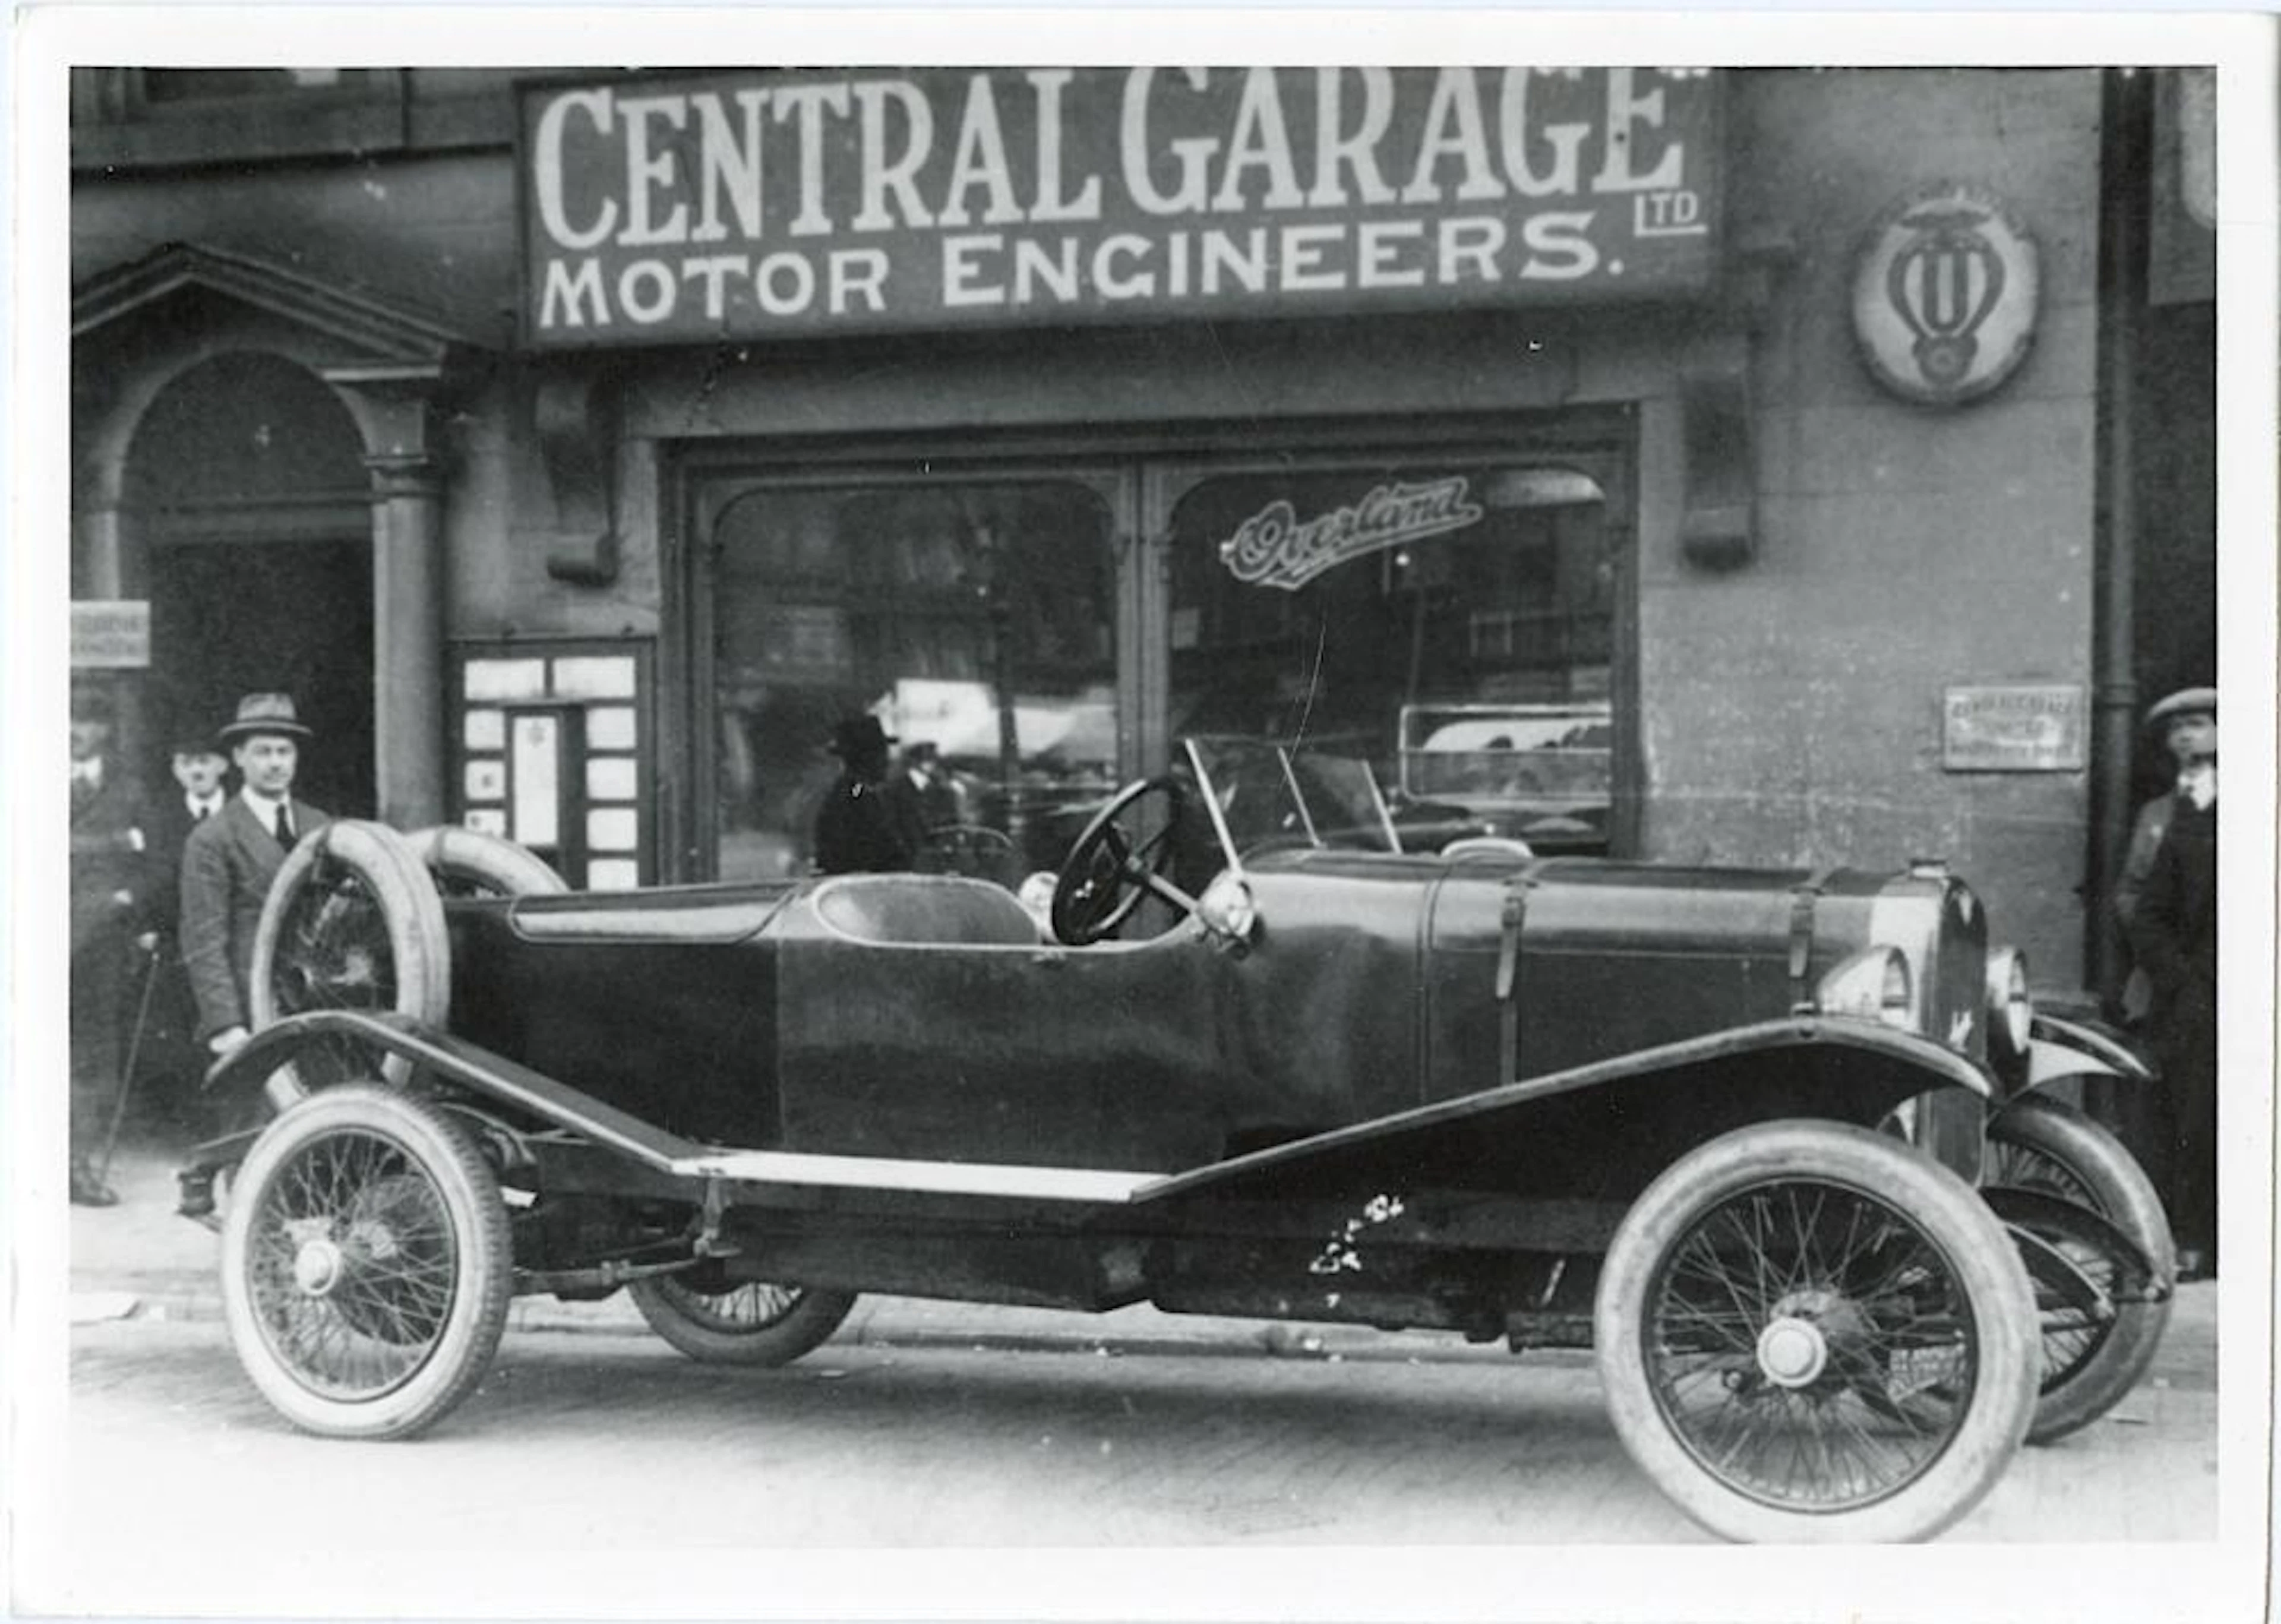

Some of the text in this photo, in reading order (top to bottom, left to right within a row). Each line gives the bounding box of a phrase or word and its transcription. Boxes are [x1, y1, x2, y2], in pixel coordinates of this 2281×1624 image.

[535, 67, 1685, 250] CENTRAL GARAGE
[1634, 190, 1709, 238] LTD
[539, 210, 1625, 328] MOTOR ENGINEERS.
[1221, 476, 1483, 590] Overland
